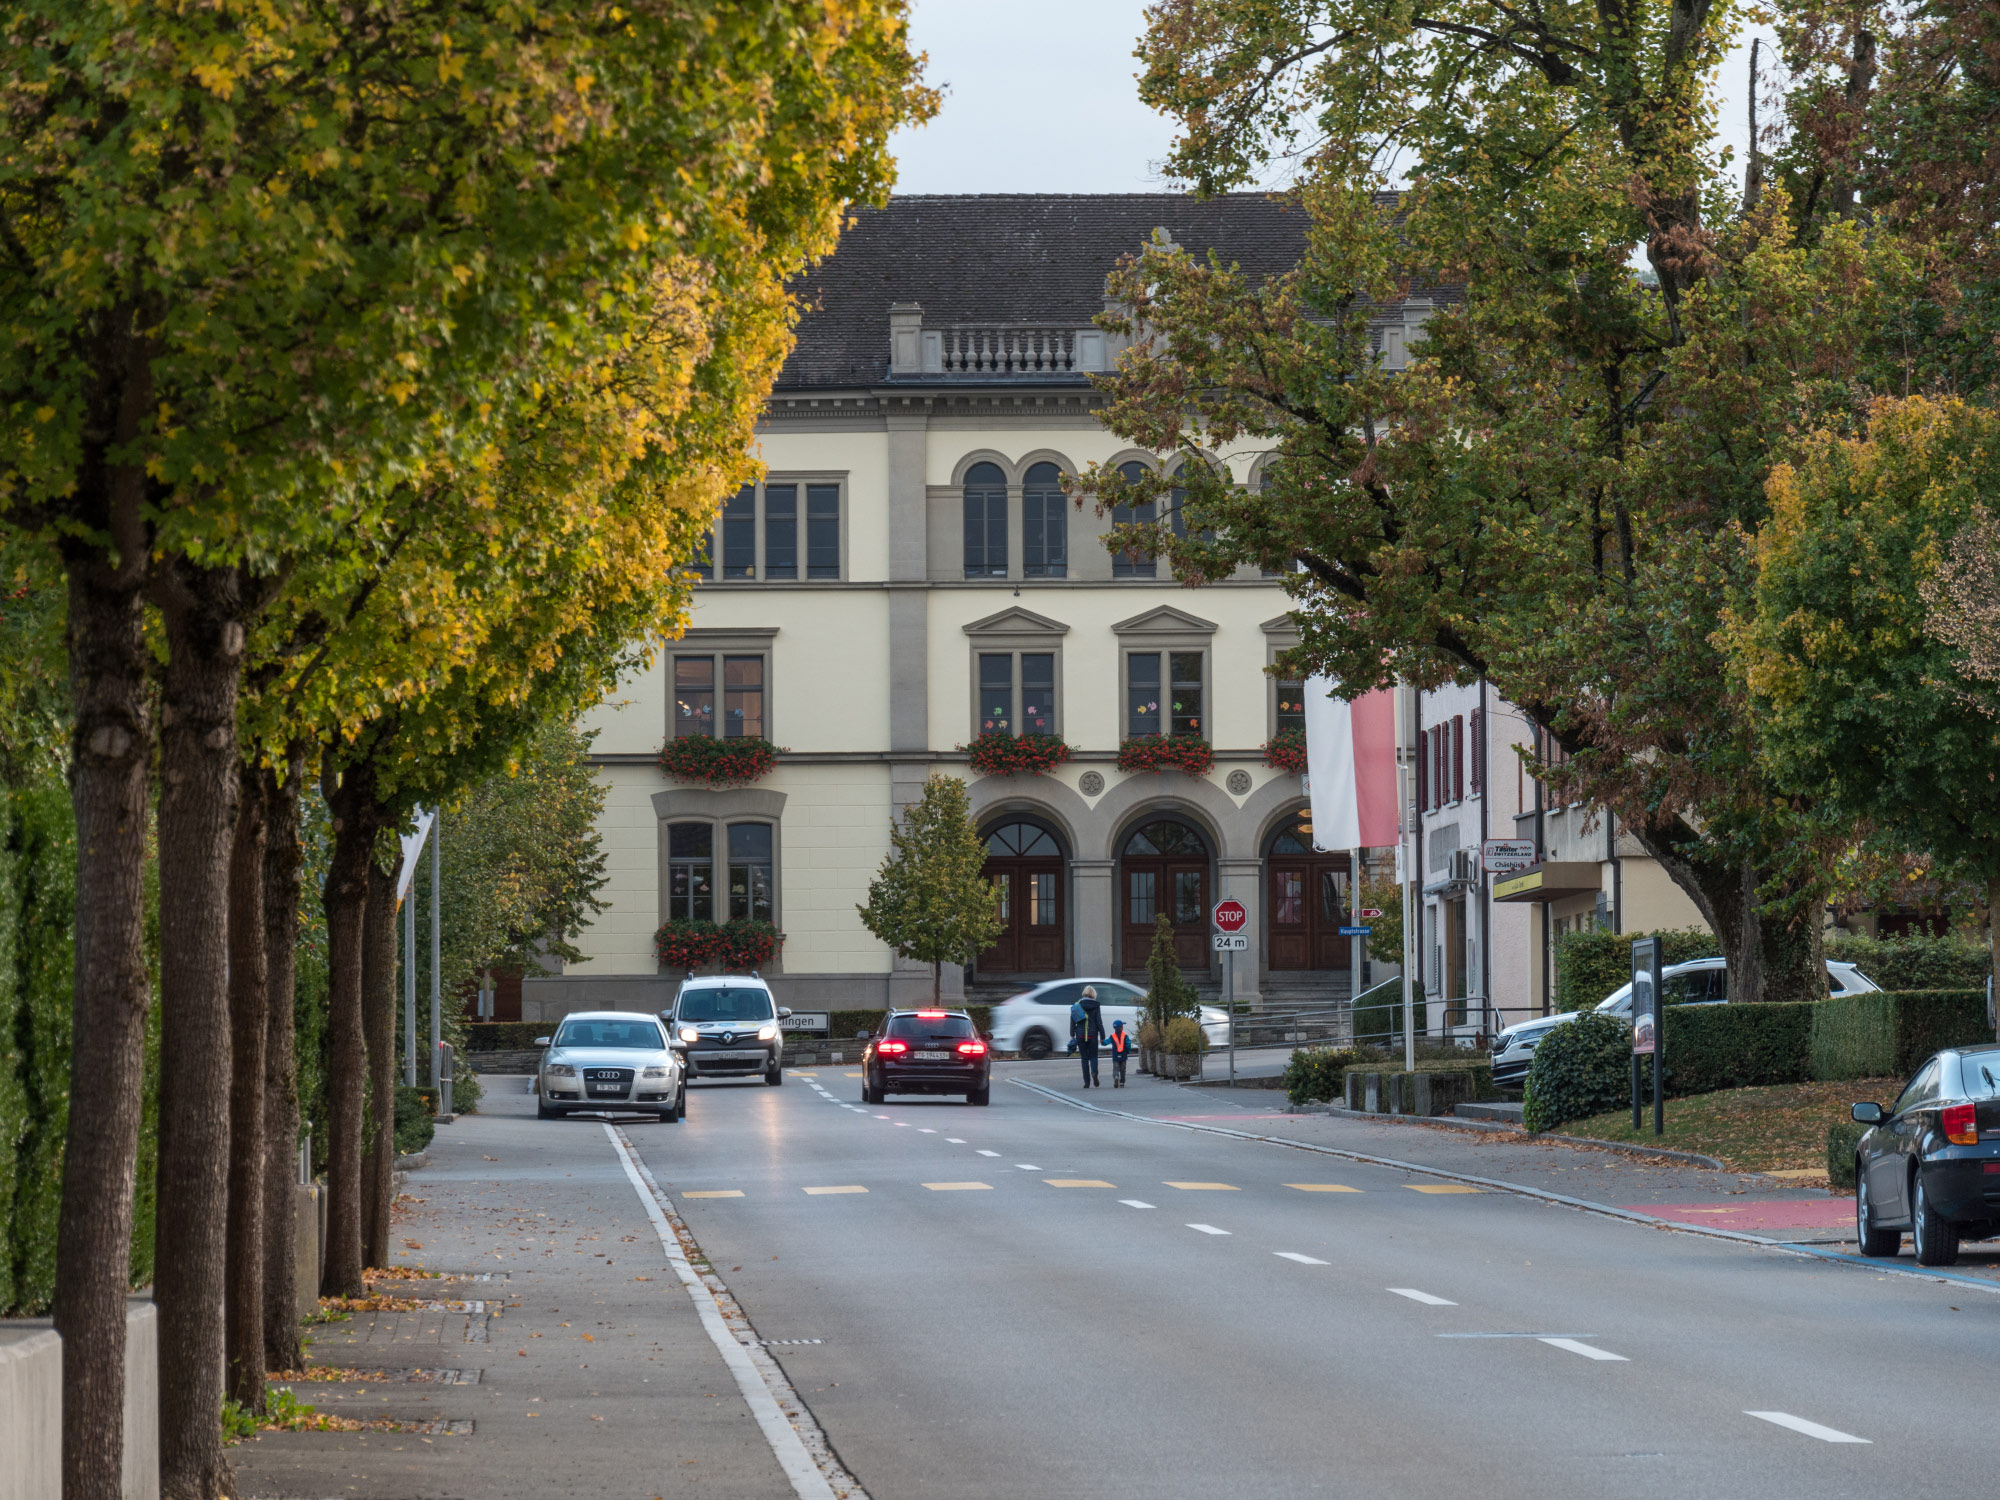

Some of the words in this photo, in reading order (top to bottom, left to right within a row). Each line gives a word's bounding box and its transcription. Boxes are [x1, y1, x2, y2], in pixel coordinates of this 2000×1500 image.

[1218, 911, 1243, 922] STOP
[1216, 937, 1231, 947] 24
[1235, 939, 1245, 947] m
